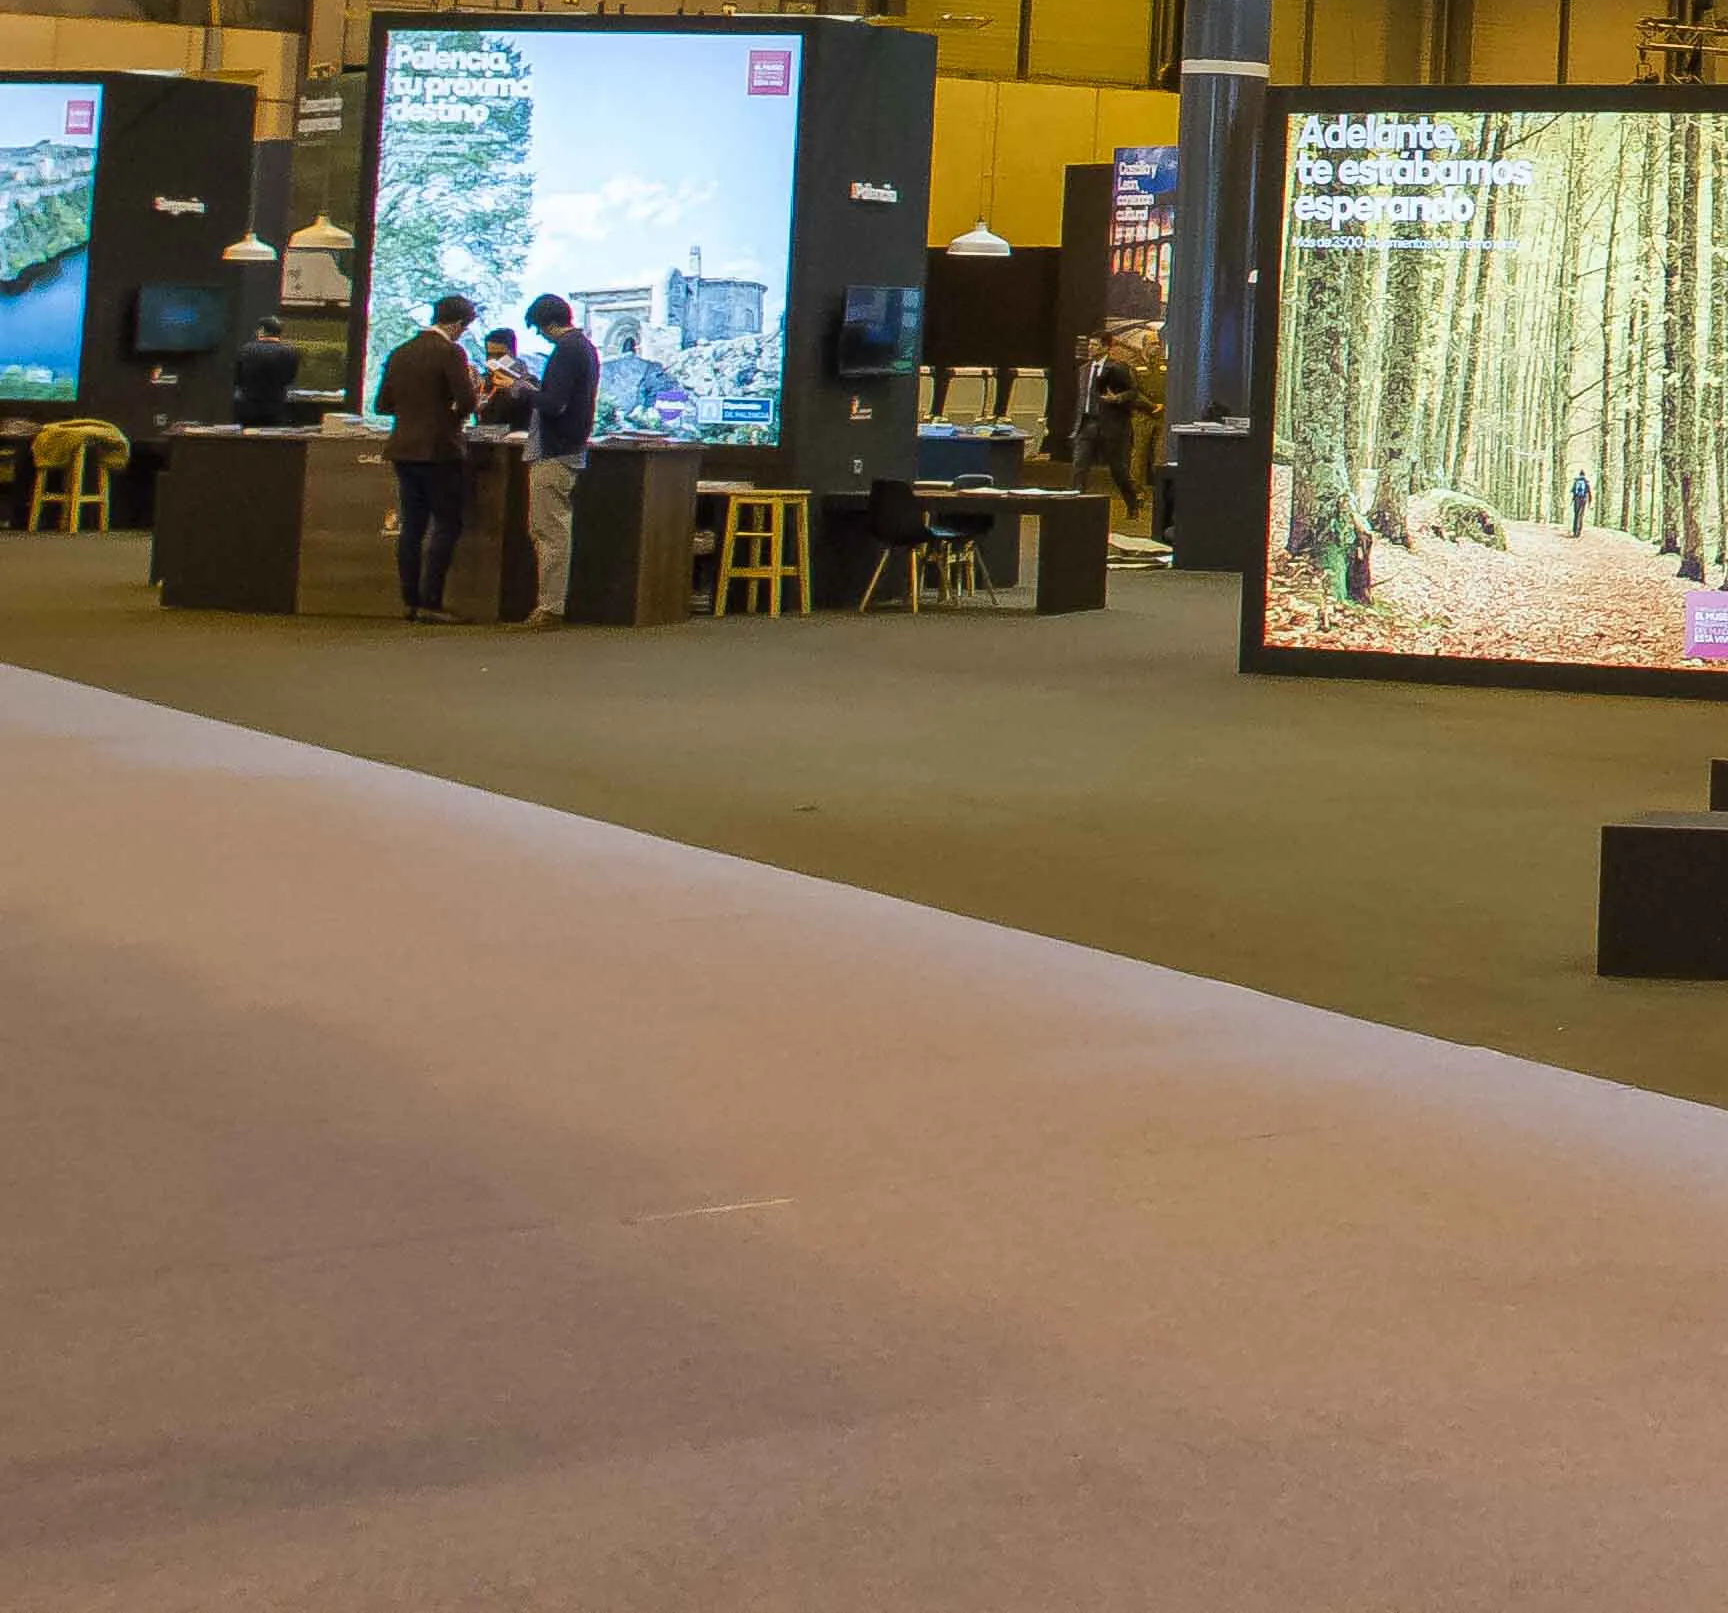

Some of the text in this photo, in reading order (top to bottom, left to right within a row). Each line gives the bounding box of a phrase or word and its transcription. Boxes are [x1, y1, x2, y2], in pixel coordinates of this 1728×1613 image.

[395, 43, 512, 74] Palencia,
[392, 71, 424, 96] tu
[391, 96, 490, 123] destino
[1296, 115, 1461, 154] Adelante,
[1295, 149, 1533, 186] te estábamos
[1294, 185, 1475, 231] esperando
